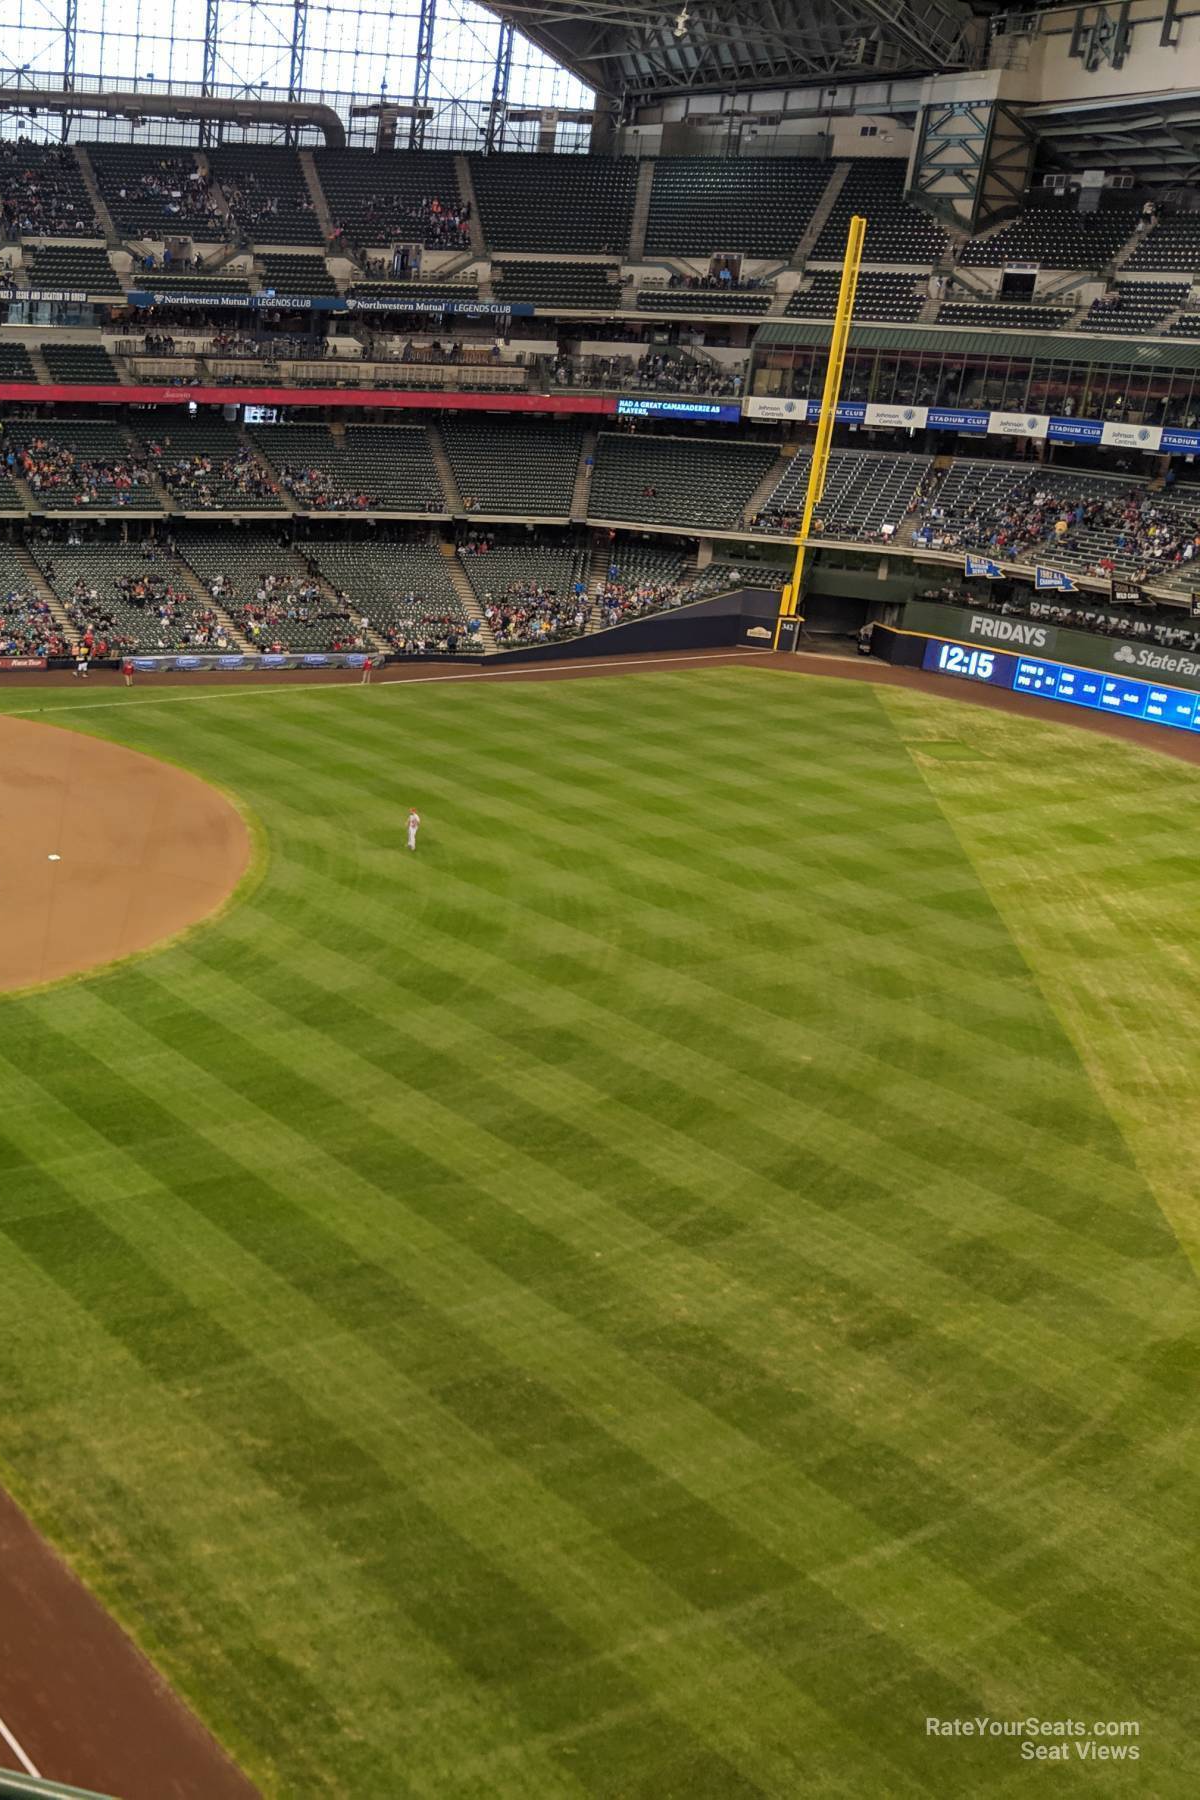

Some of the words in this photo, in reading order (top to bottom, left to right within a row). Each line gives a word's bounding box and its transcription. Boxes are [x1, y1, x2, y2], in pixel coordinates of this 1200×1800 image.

[164, 295, 219, 305] Northwestern
[221, 297, 249, 306] Mutual
[257, 298, 291, 307] LEGENDS
[292, 299, 311, 307] CLUB
[357, 301, 413, 310] Northwestern
[416, 303, 445, 311] Mutual
[454, 304, 489, 313] LEGENDS
[490, 305, 511, 313] CLUB
[640, 401, 662, 409] GREAT
[929, 415, 965, 423] STADIUM
[1050, 425, 1081, 433] STADIUM
[1163, 436, 1198, 445] STADIUM
[970, 615, 1047, 647] FRIDAYS
[939, 645, 995, 678] 12:15
